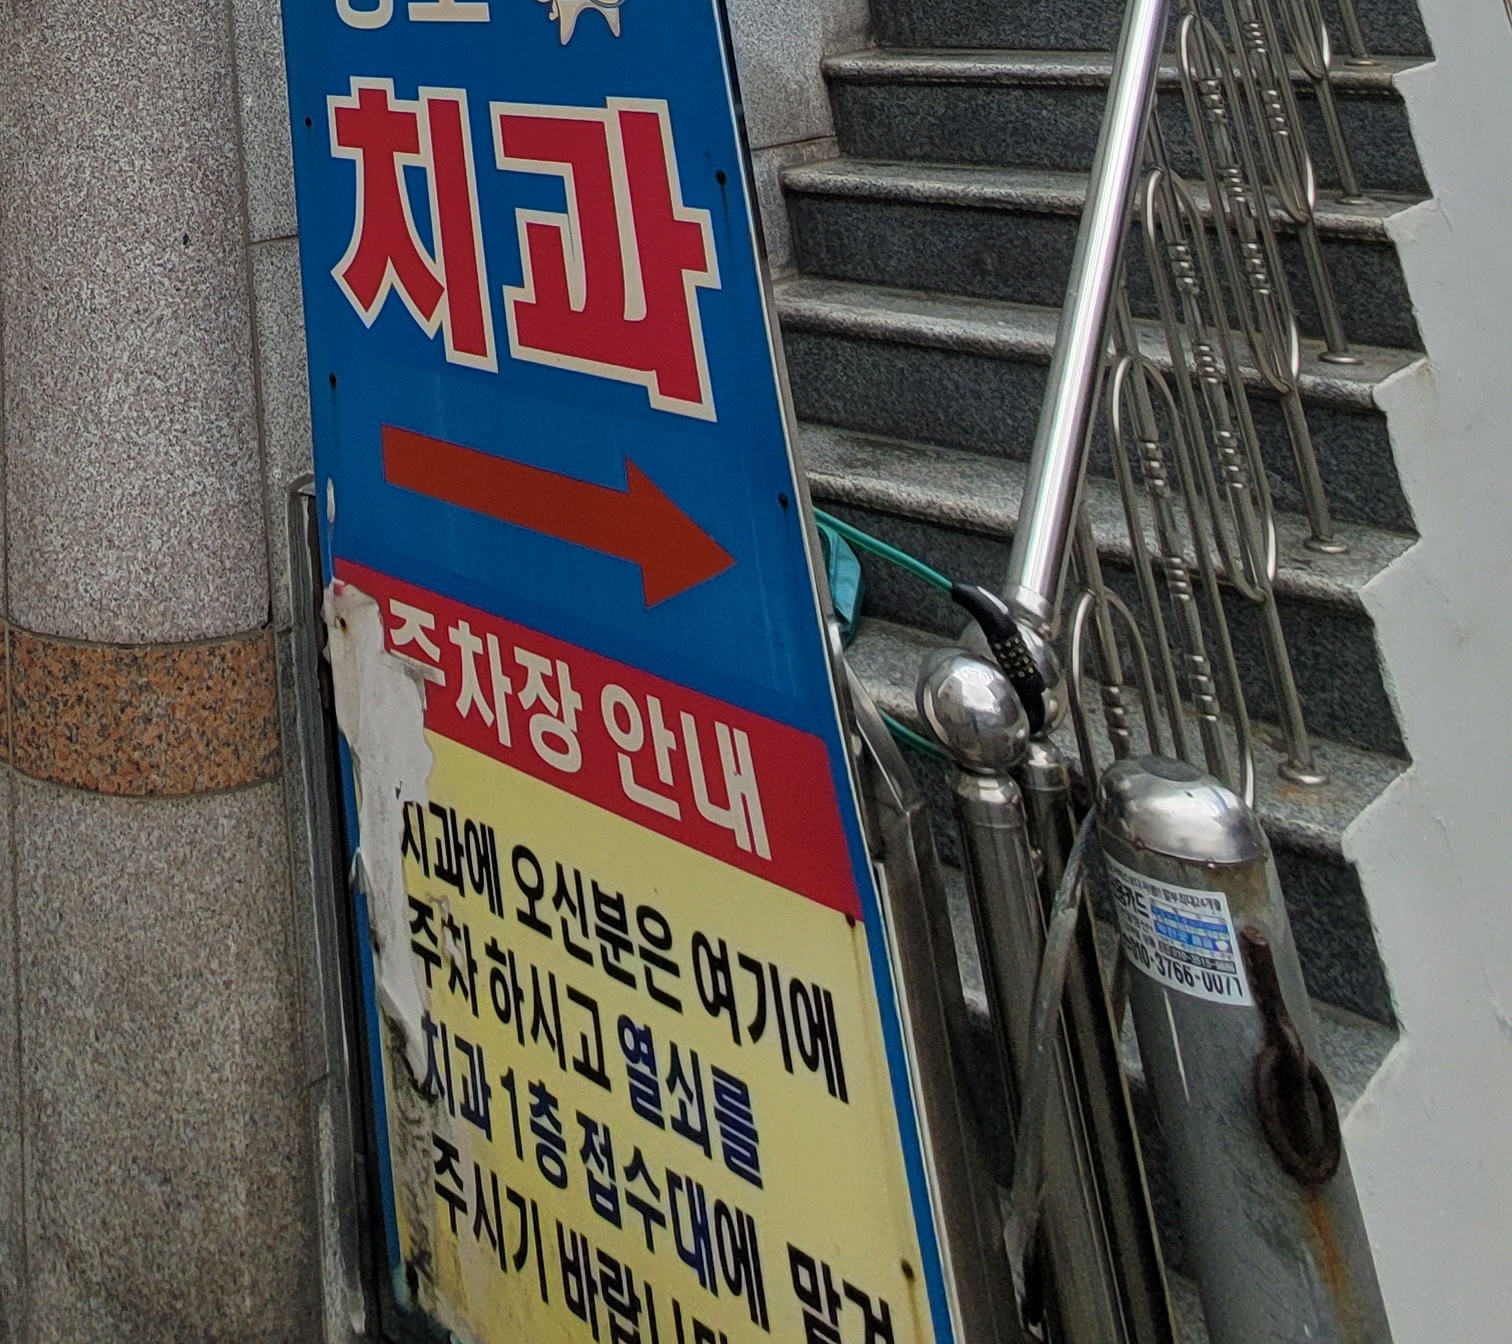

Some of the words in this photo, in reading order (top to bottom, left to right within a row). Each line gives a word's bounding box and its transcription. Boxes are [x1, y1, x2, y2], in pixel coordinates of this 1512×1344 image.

[325, 75, 723, 423] 치과
[389, 598, 583, 774] 주차장
[600, 683, 773, 862] 안내
[512, 843, 684, 1015] 오신분은
[691, 929, 850, 1105] 여기에
[617, 1013, 764, 1190] 열쇠를
[422, 1009, 493, 1143] 치과
[500, 1066, 568, 1191] 1층
[576, 1110, 771, 1334] 접수대에
[432, 1132, 550, 1305] 주시기
